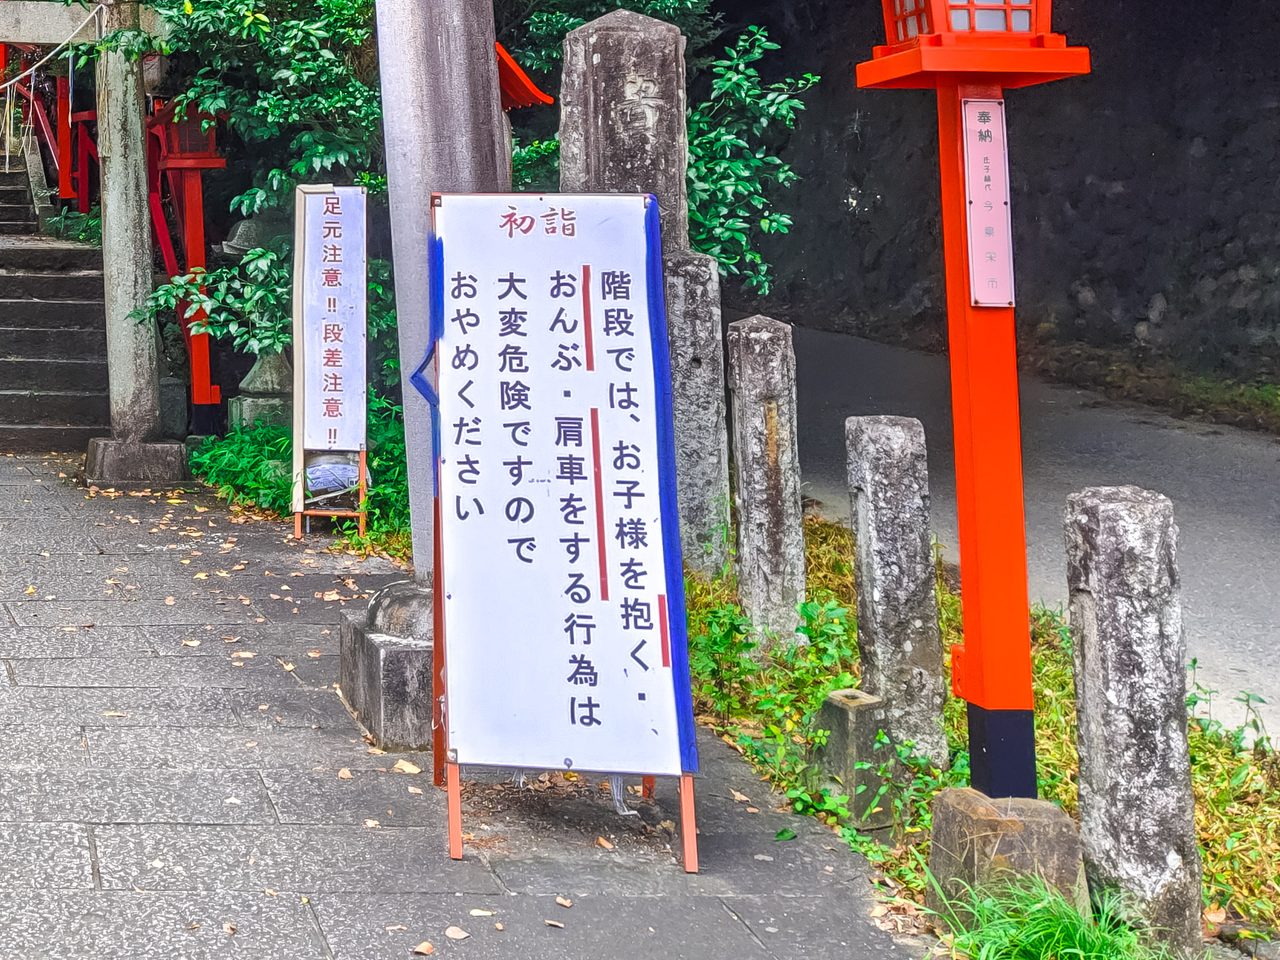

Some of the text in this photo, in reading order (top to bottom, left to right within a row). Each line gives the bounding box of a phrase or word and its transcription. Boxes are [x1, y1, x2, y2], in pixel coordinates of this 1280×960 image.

[499, 205, 577, 239] 初詣
[977, 110, 993, 143] 奉納
[450, 271, 485, 521] おやめください
[497, 271, 537, 564] 大変危険ですので
[549, 269, 602, 727] おんぶ・肩車をする行為は
